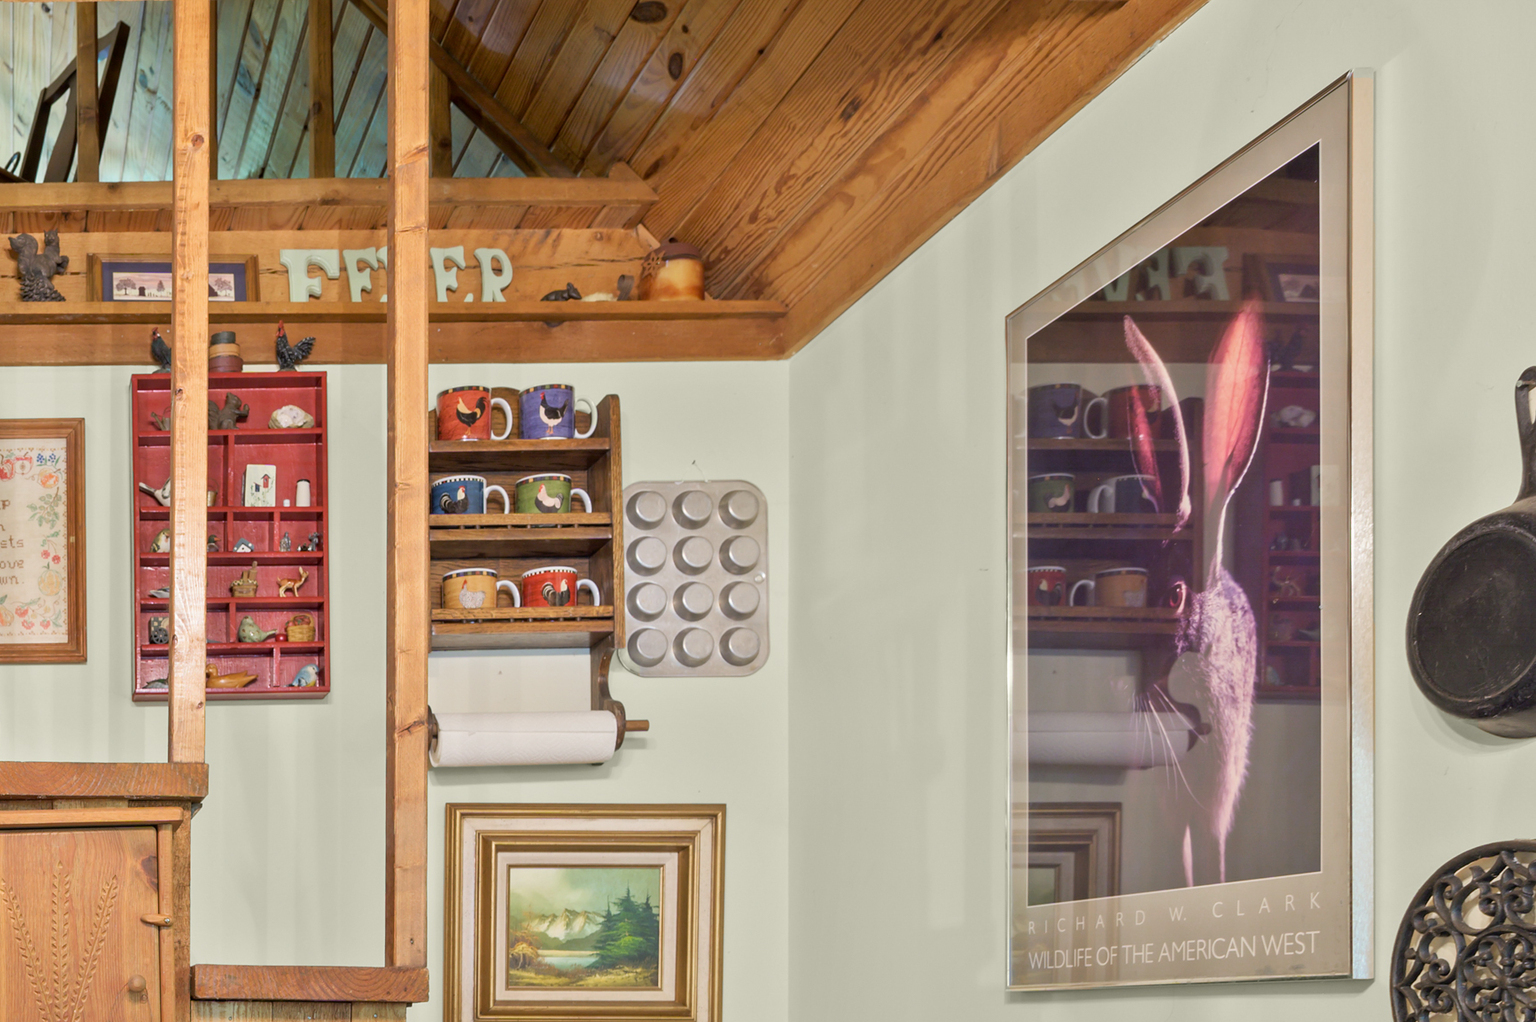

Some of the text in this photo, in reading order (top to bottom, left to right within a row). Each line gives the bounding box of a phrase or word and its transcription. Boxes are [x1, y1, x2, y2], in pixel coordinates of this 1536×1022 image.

[279, 245, 513, 303] FEER
[1028, 891, 1321, 935] RICHARD W. CLARK
[1028, 930, 1321, 970] WILDLIFE OF THE AMERICAN WEST
